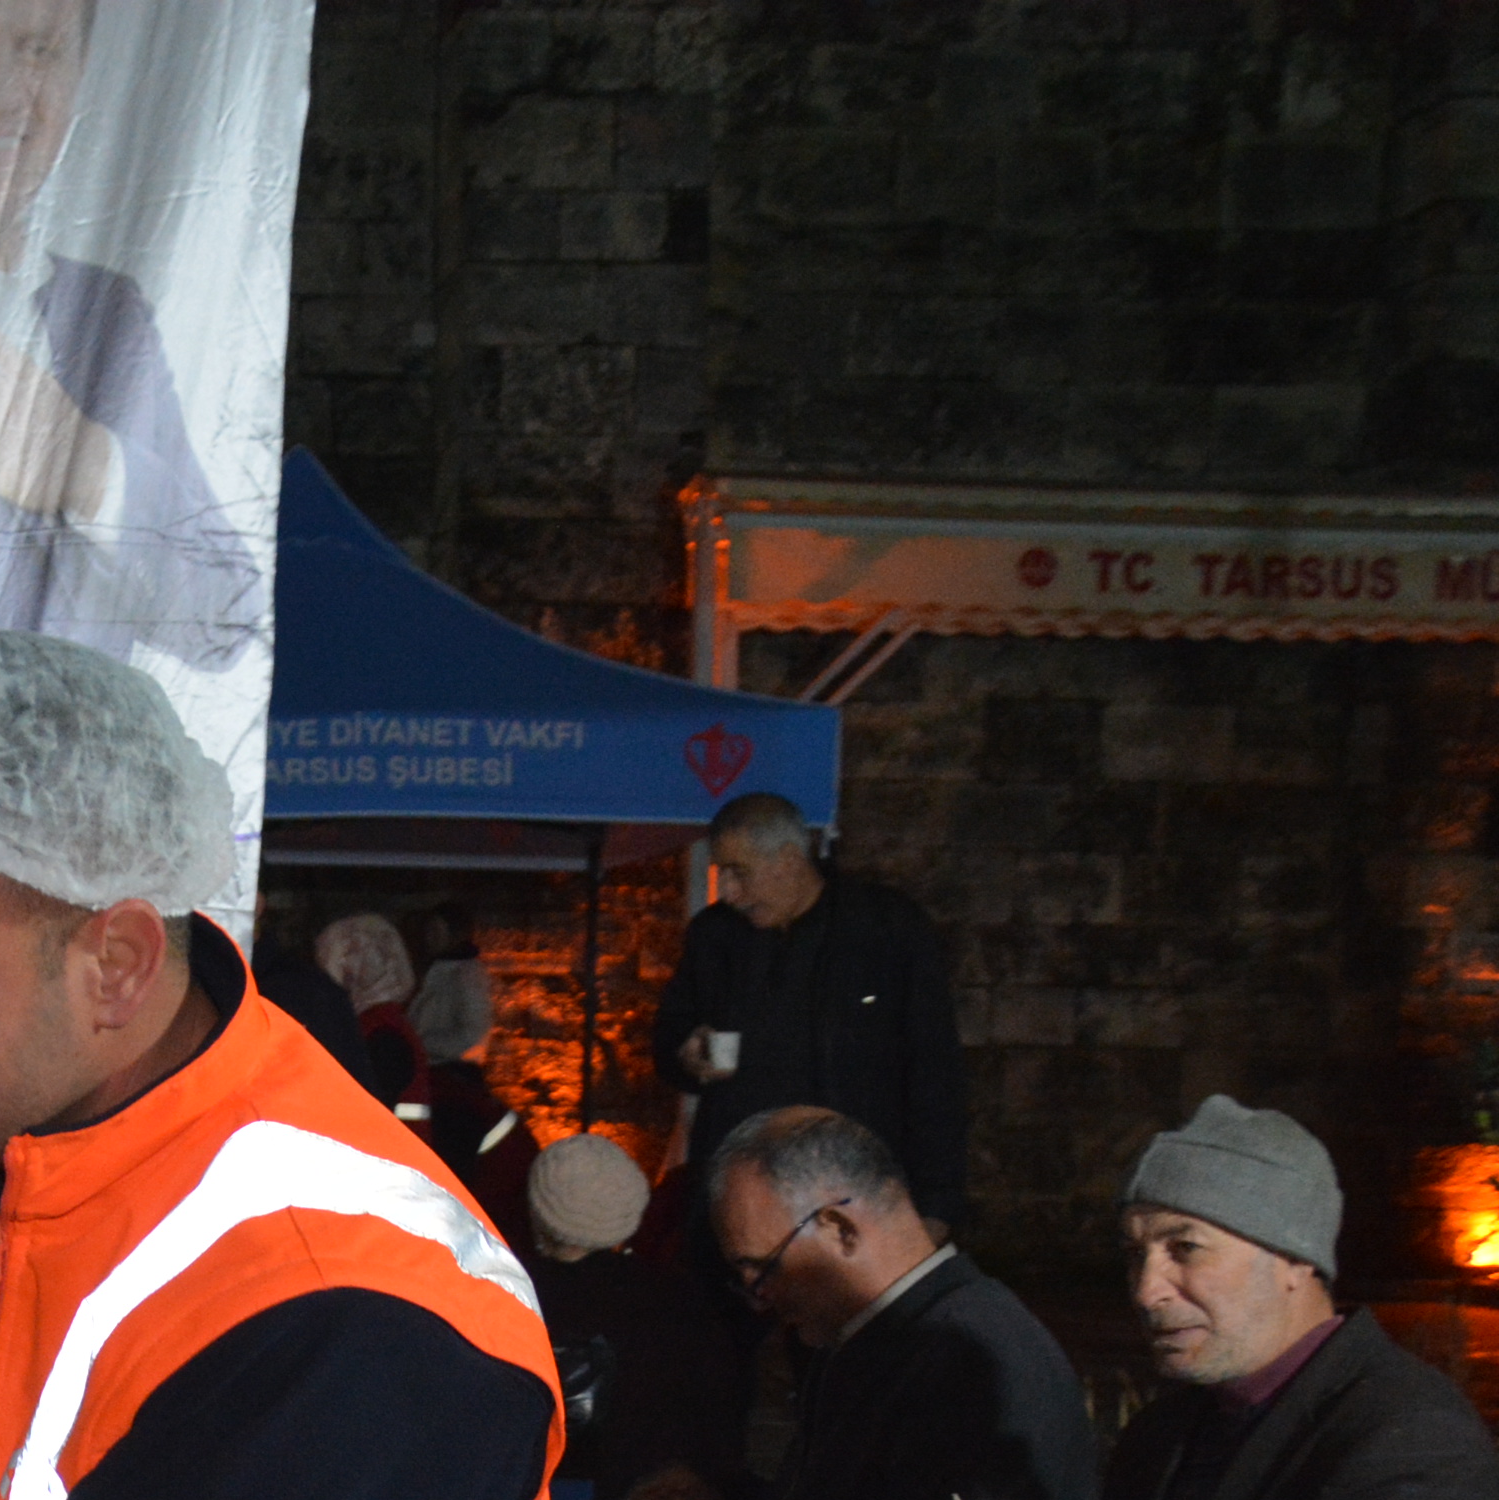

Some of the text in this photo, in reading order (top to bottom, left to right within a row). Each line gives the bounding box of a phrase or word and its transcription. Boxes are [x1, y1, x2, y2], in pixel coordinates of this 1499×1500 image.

[1088, 551, 1155, 595] TC
[1192, 551, 1399, 599] TARSUS
[329, 711, 476, 749] DİYANET
[485, 718, 585, 750] VAKFI
[266, 752, 514, 789] ARSUS ŞUBESİ
